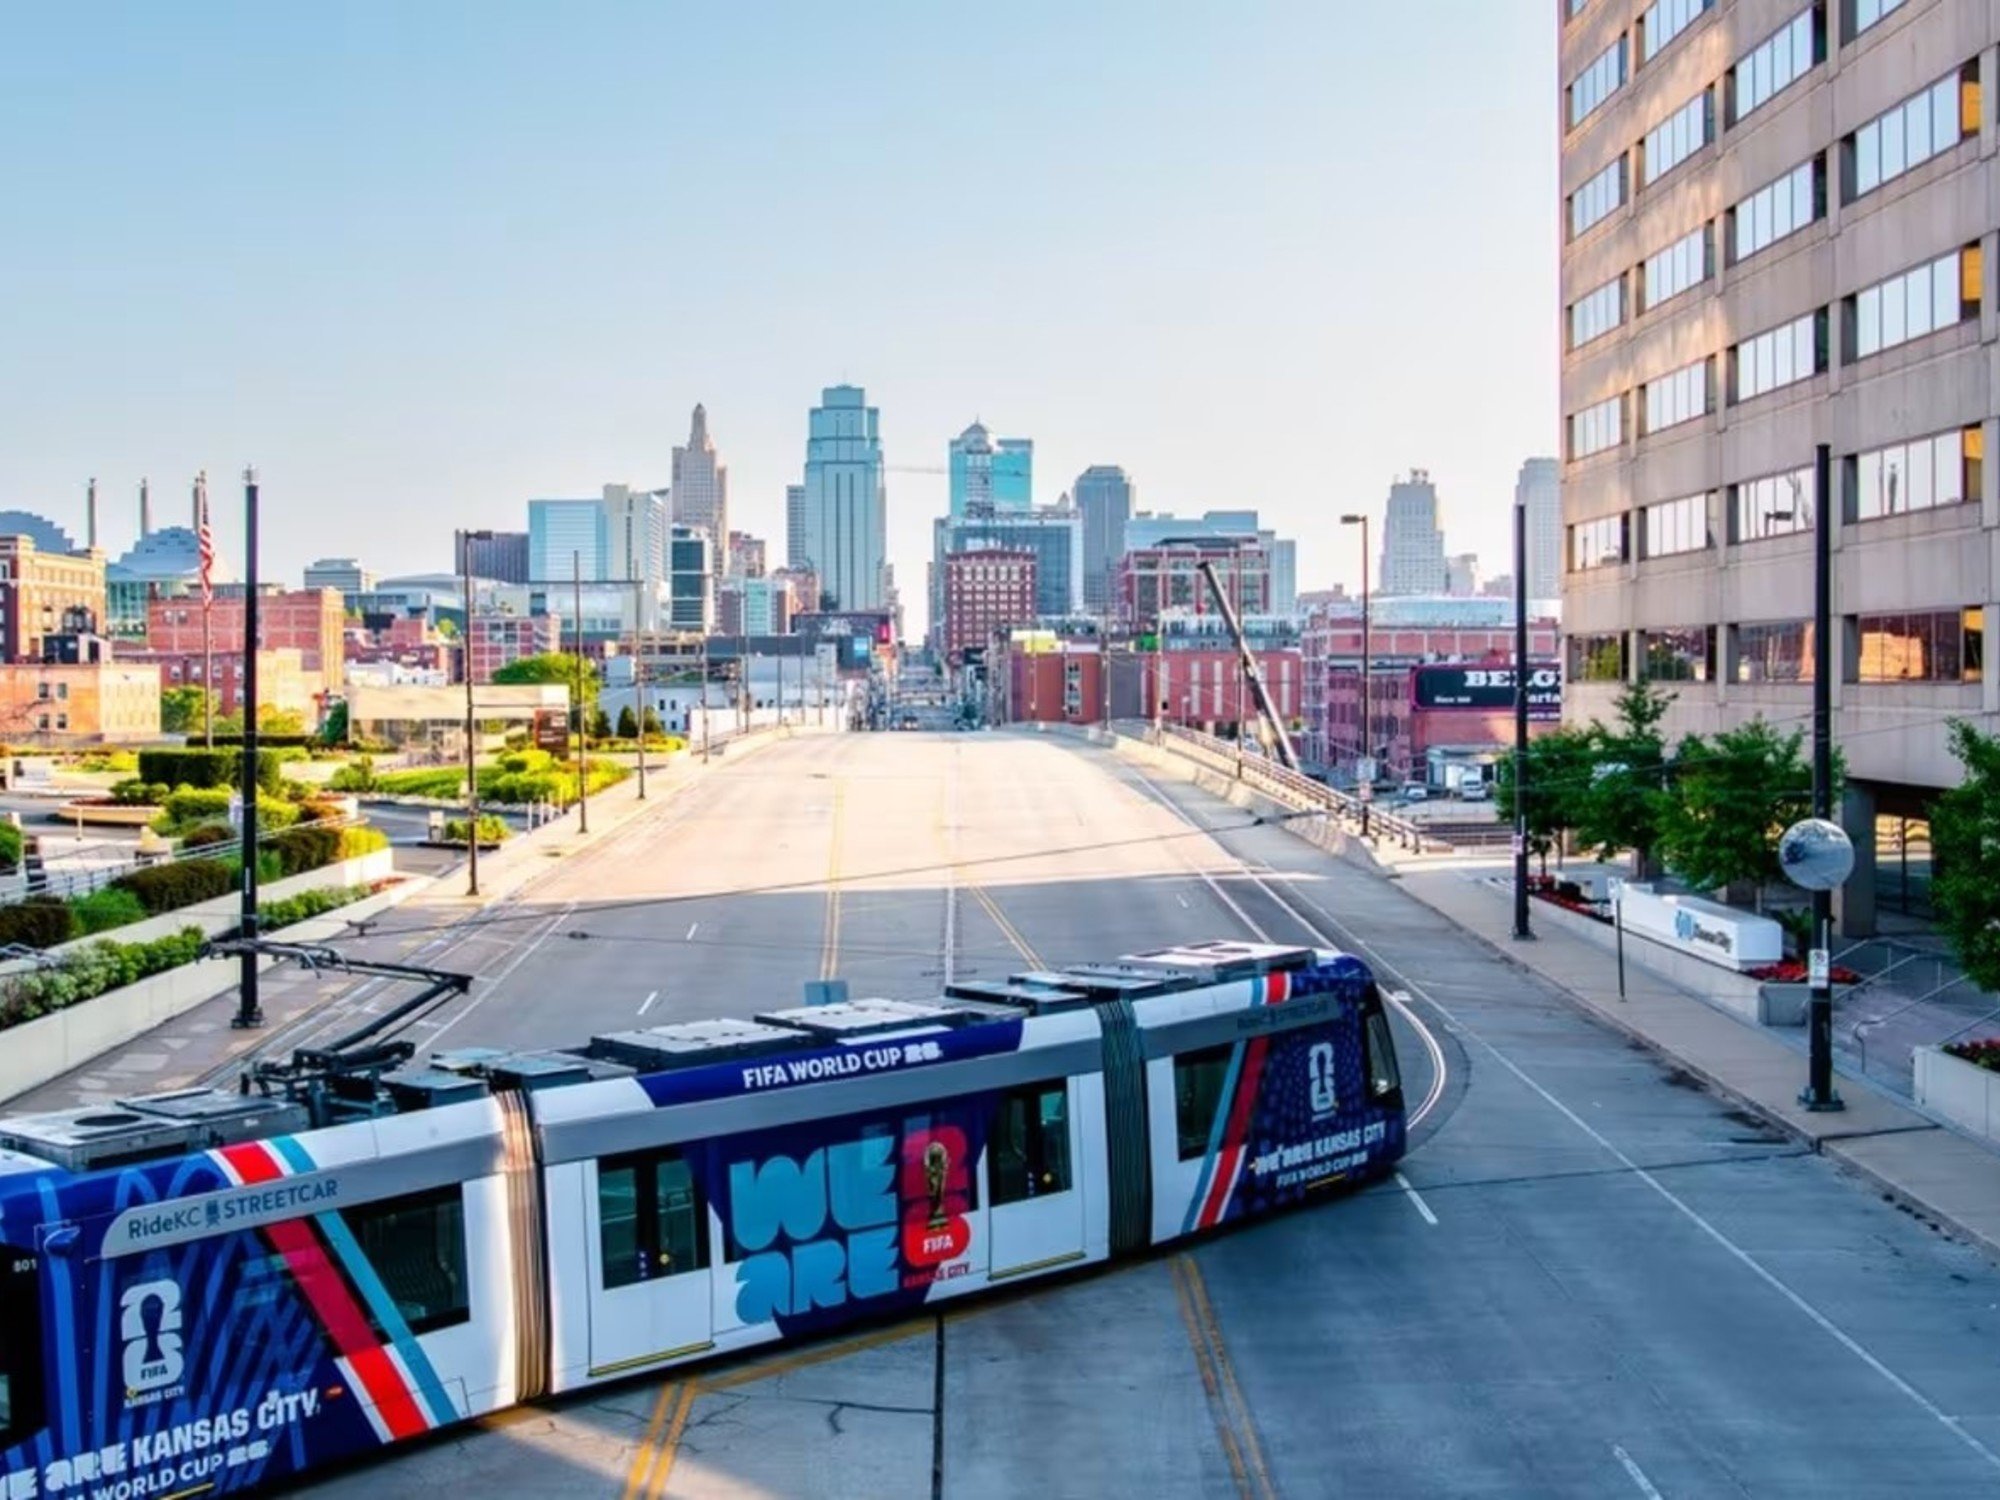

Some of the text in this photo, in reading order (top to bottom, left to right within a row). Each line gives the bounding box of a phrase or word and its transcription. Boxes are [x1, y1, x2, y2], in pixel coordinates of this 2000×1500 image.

[743, 1063, 790, 1089] FIFA
[789, 1053, 862, 1081] WORLD
[864, 1046, 902, 1070] CUP
[1314, 1128, 1361, 1158] KANSAS
[1363, 1120, 1386, 1145] CITY
[1304, 1160, 1333, 1180] WORLD
[128, 1179, 338, 1240] RideKC STREETCAR
[730, 1136, 897, 1250] WE
[923, 1233, 954, 1254] FIFA
[13, 1258, 37, 1273] 801
[140, 1364, 169, 1381] FIFA
[132, 1408, 250, 1468] KANSAS
[257, 1389, 318, 1430] CITY
[92, 1467, 176, 1500] WORLD
[178, 1452, 224, 1482] CUP
